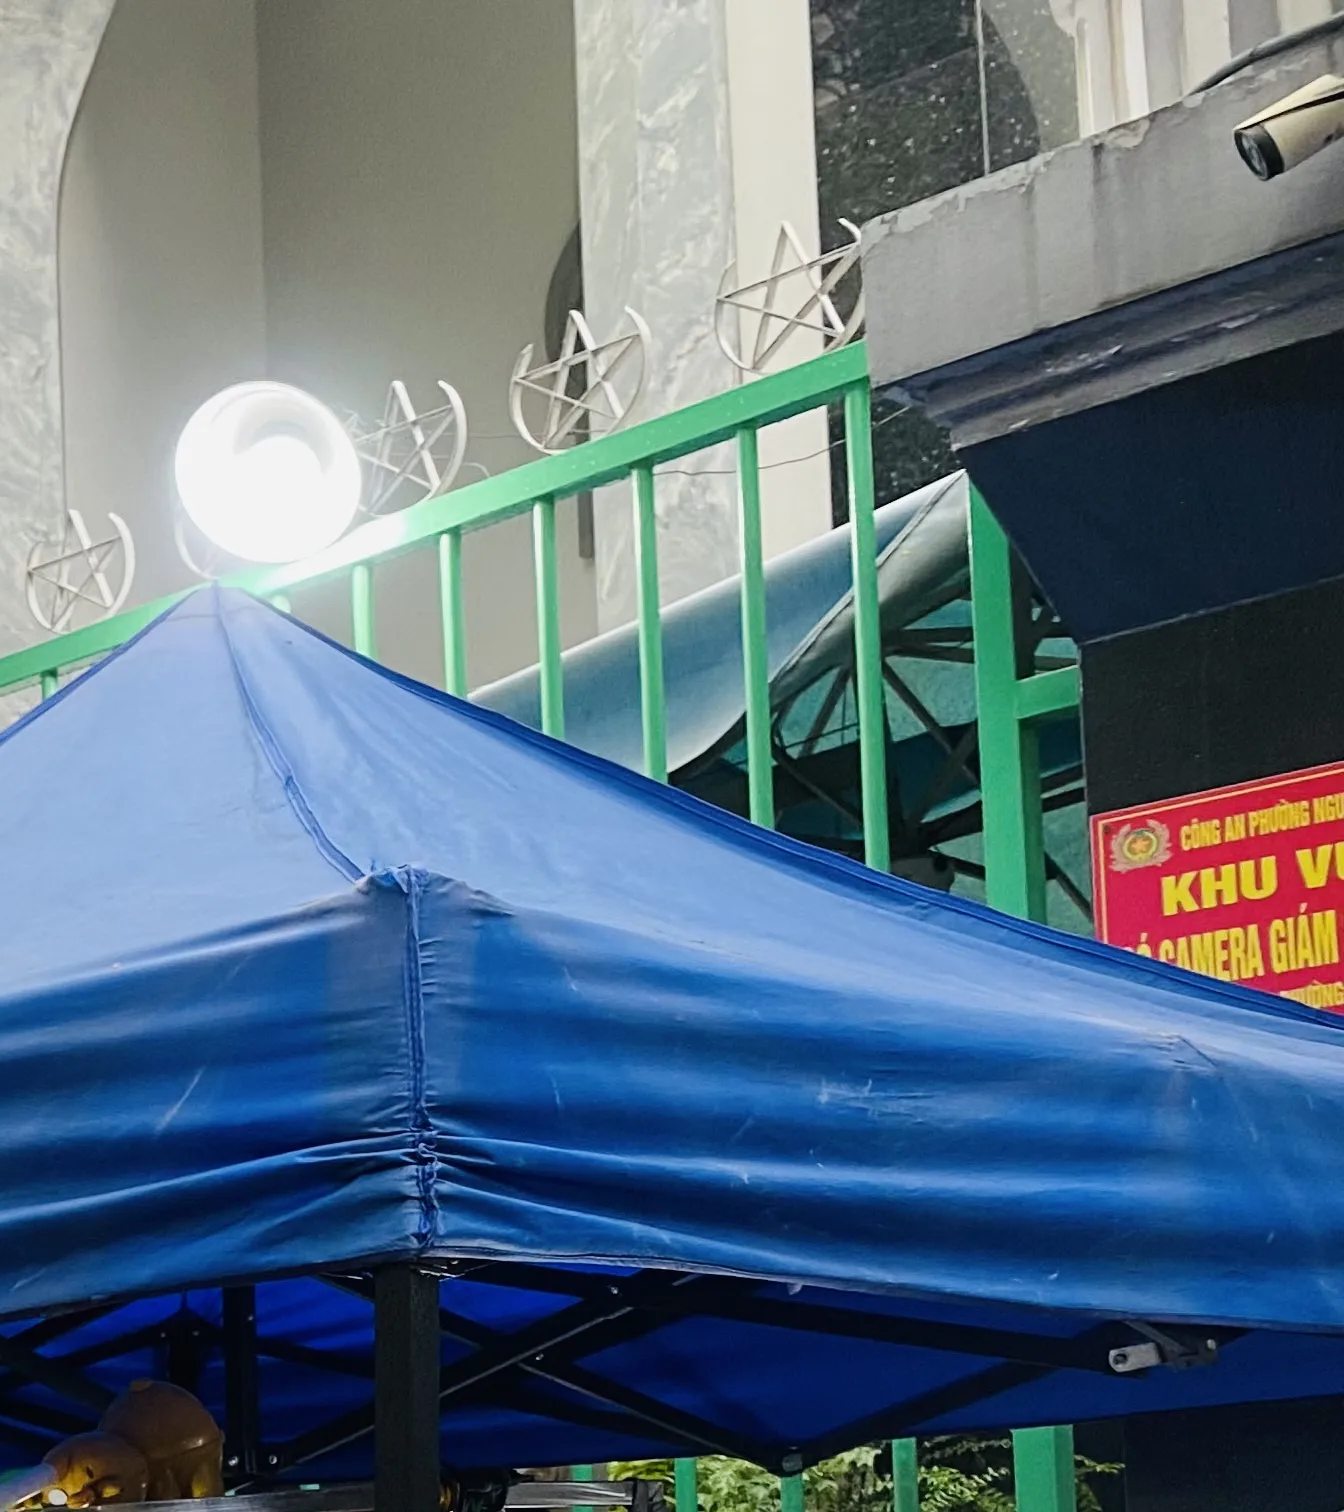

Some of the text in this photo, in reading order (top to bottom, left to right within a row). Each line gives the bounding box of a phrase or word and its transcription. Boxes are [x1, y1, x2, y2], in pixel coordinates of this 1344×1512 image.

[1180, 817, 1222, 851] CÔNG
[1224, 812, 1246, 843] AN
[1162, 854, 1278, 917] KHU
[1269, 902, 1340, 974] GIÁM
